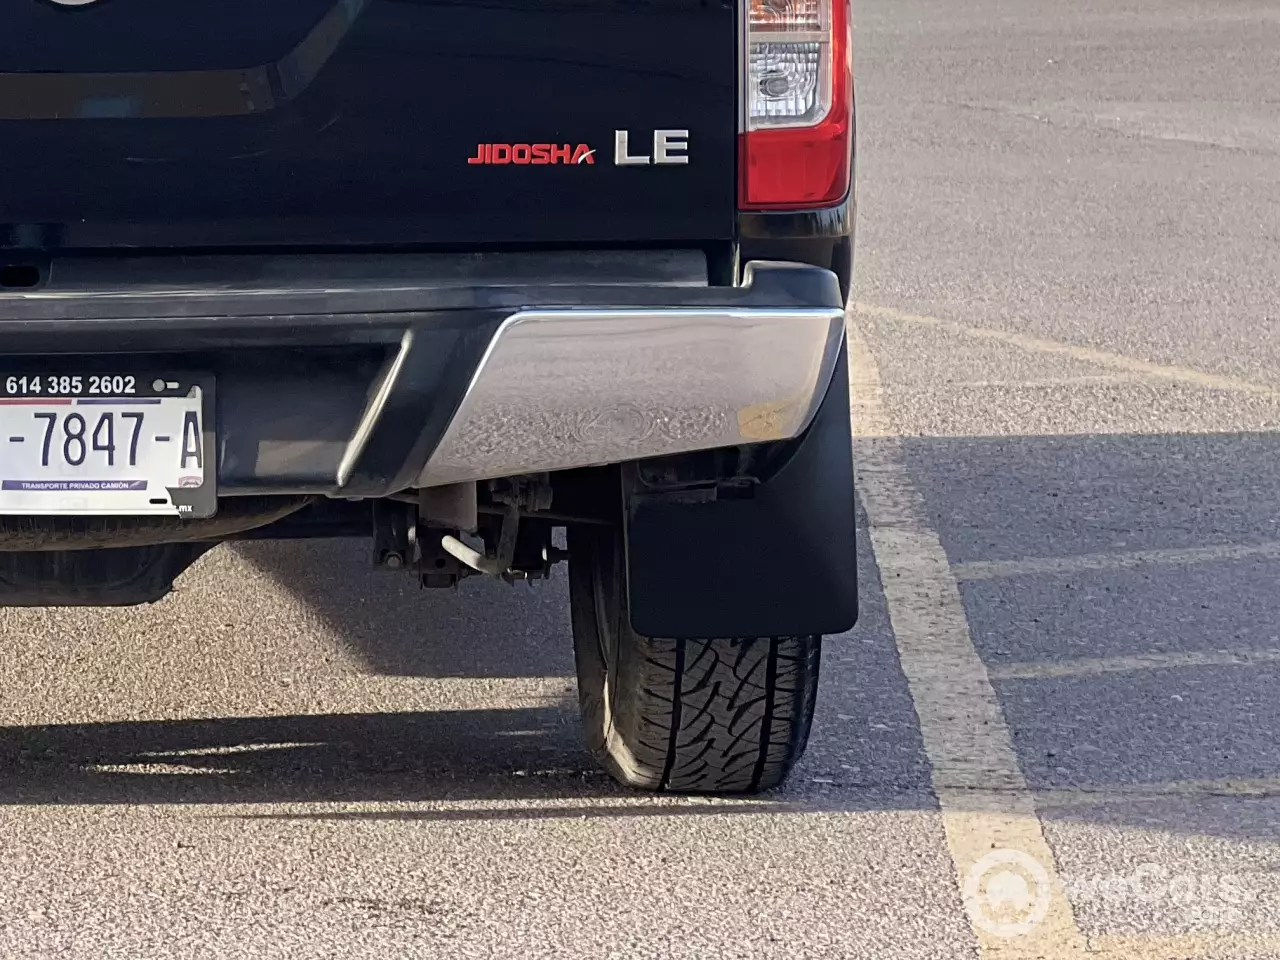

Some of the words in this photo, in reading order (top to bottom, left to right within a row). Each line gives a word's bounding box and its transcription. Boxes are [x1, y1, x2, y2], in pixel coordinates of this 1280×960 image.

[467, 143, 597, 165] JIDOSHA
[614, 129, 689, 166] LE
[6, 375, 41, 394] 614
[47, 375, 83, 394] 385
[88, 375, 136, 394] 2602
[21, 482, 68, 490] TRANSPORTE
